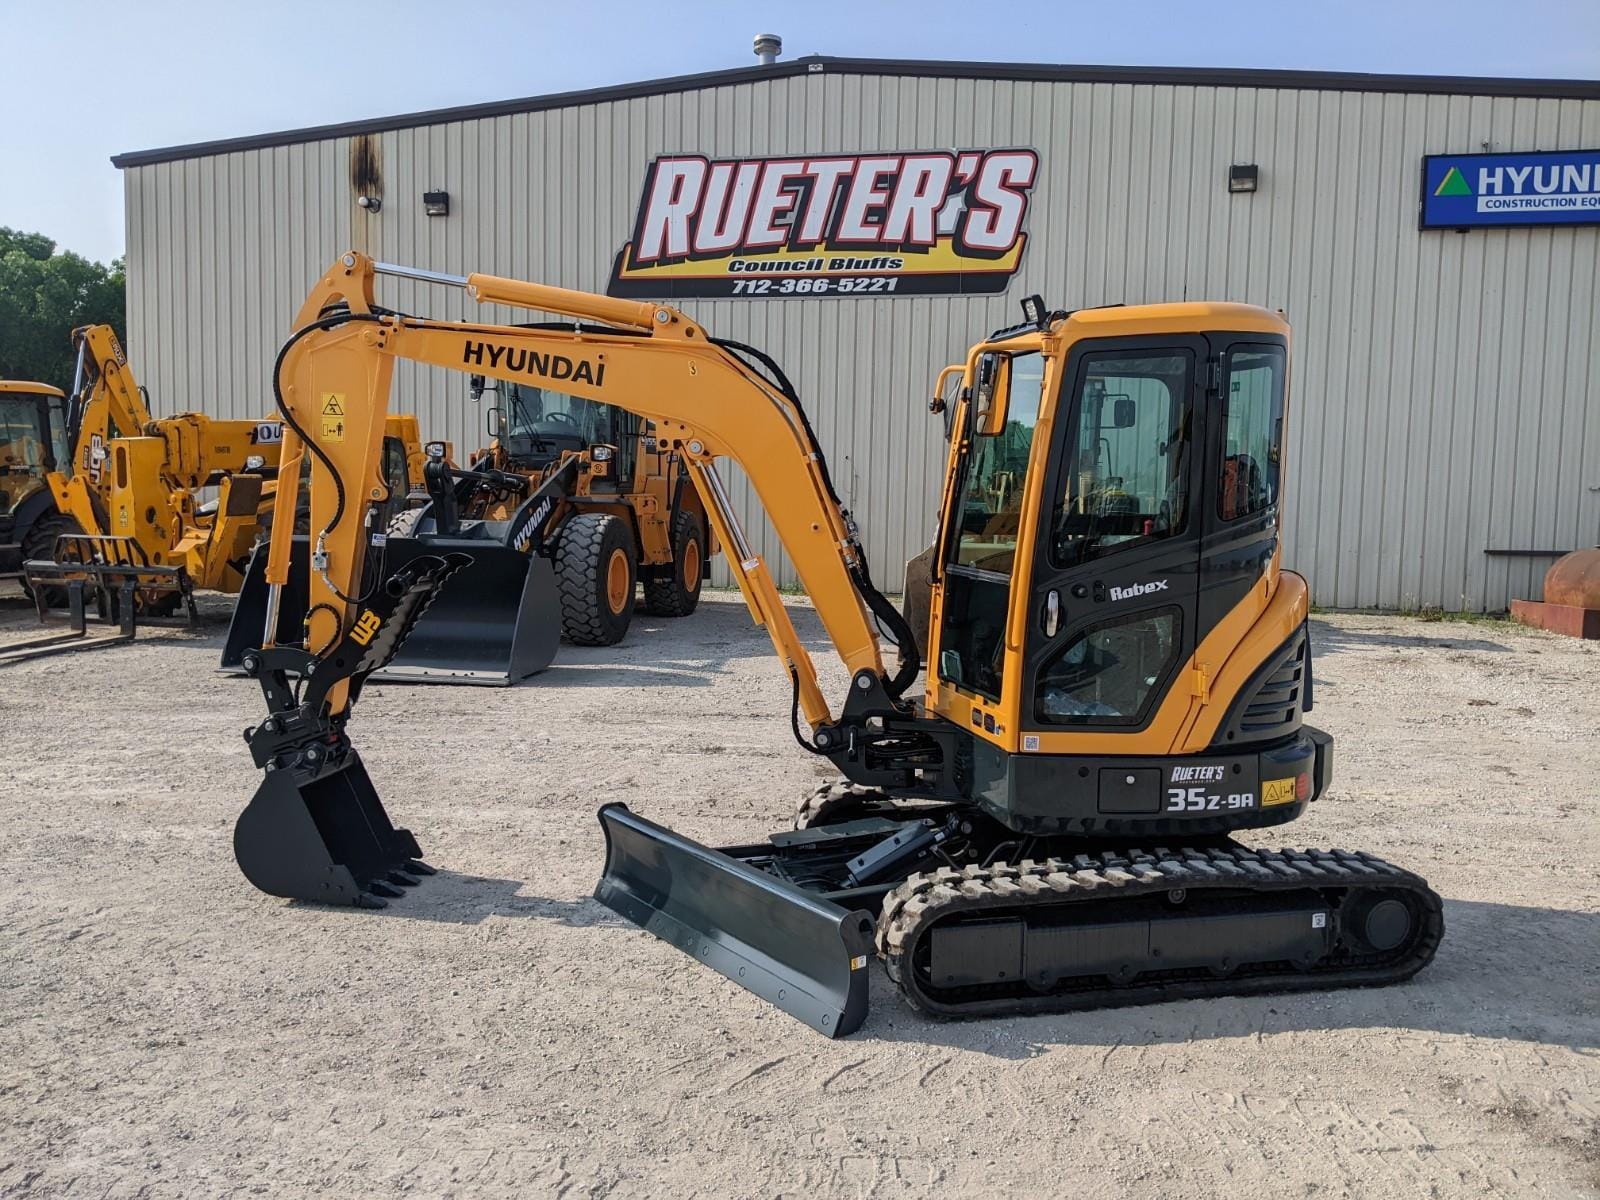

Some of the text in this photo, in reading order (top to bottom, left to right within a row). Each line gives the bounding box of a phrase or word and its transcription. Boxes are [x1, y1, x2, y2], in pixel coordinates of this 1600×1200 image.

[1478, 163, 1600, 195] HYUN
[636, 151, 1038, 262] RUETER'S
[1485, 196, 1600, 209] CONSTRUCTION EQ
[728, 256, 904, 272] Council Bluffs
[732, 276, 899, 294] 712-366-5221
[513, 495, 551, 551] HYUNDAI
[1110, 579, 1169, 601] Robex
[1170, 765, 1225, 782] RUETER'S
